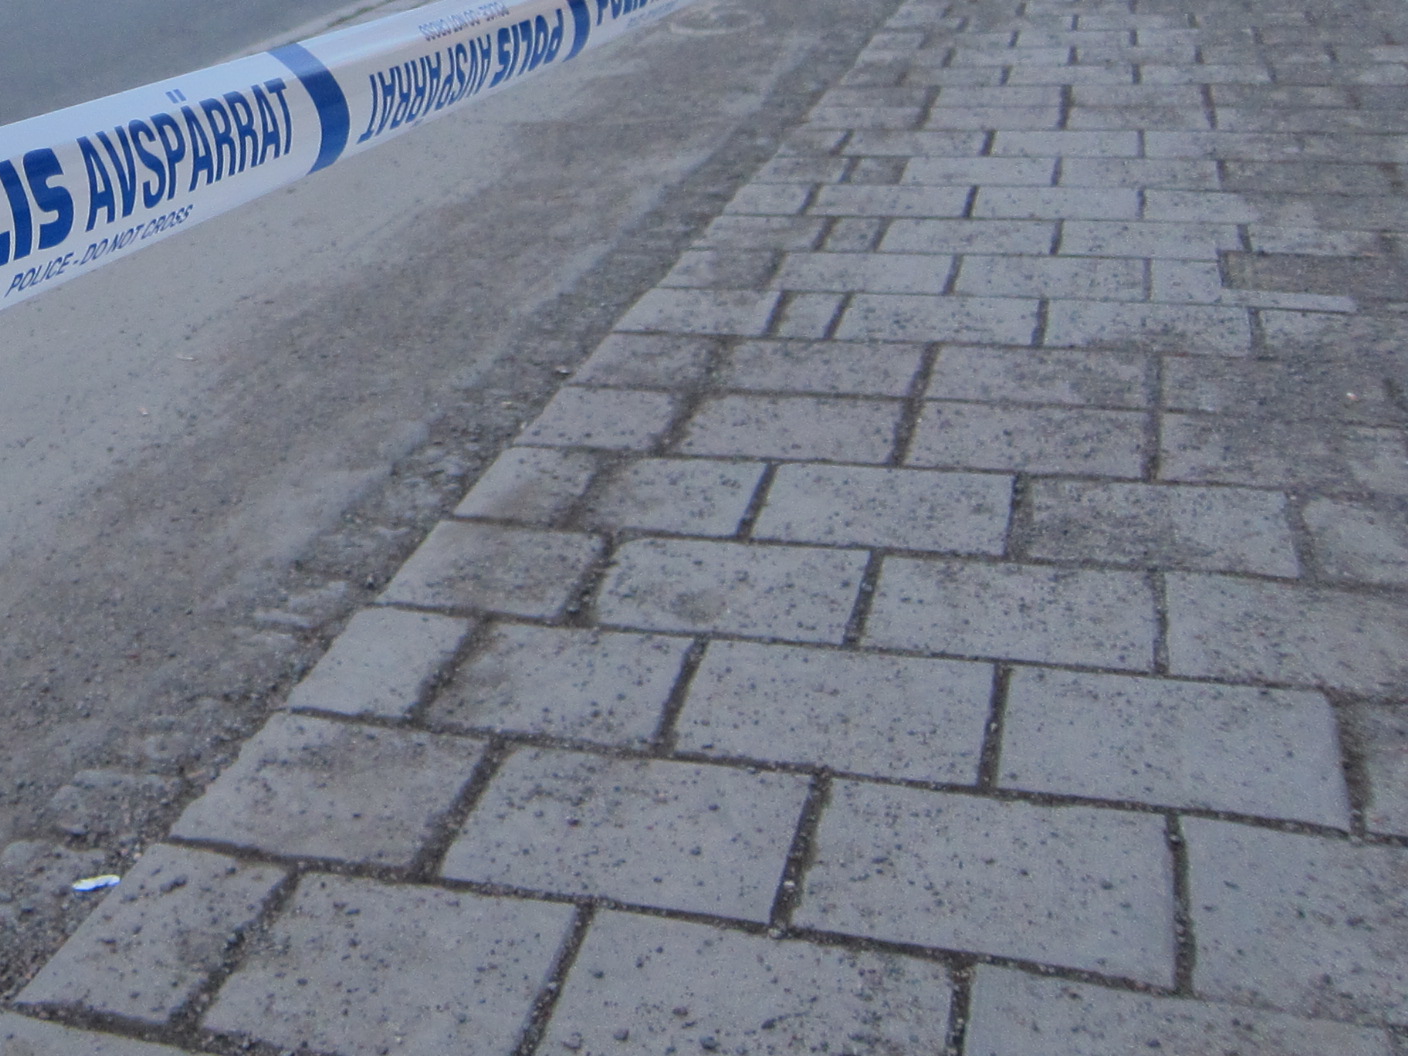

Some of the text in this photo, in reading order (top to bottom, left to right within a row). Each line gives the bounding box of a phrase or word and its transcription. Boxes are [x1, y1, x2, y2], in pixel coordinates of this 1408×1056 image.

[356, 8, 564, 144] POLIS AVSPÄRRAT
[76, 78, 292, 231] AVSPÄRRAT
[4, 251, 74, 298] POLICE
[79, 238, 109, 266] DO
[106, 224, 146, 256] NOT
[142, 204, 194, 240] CROSS
